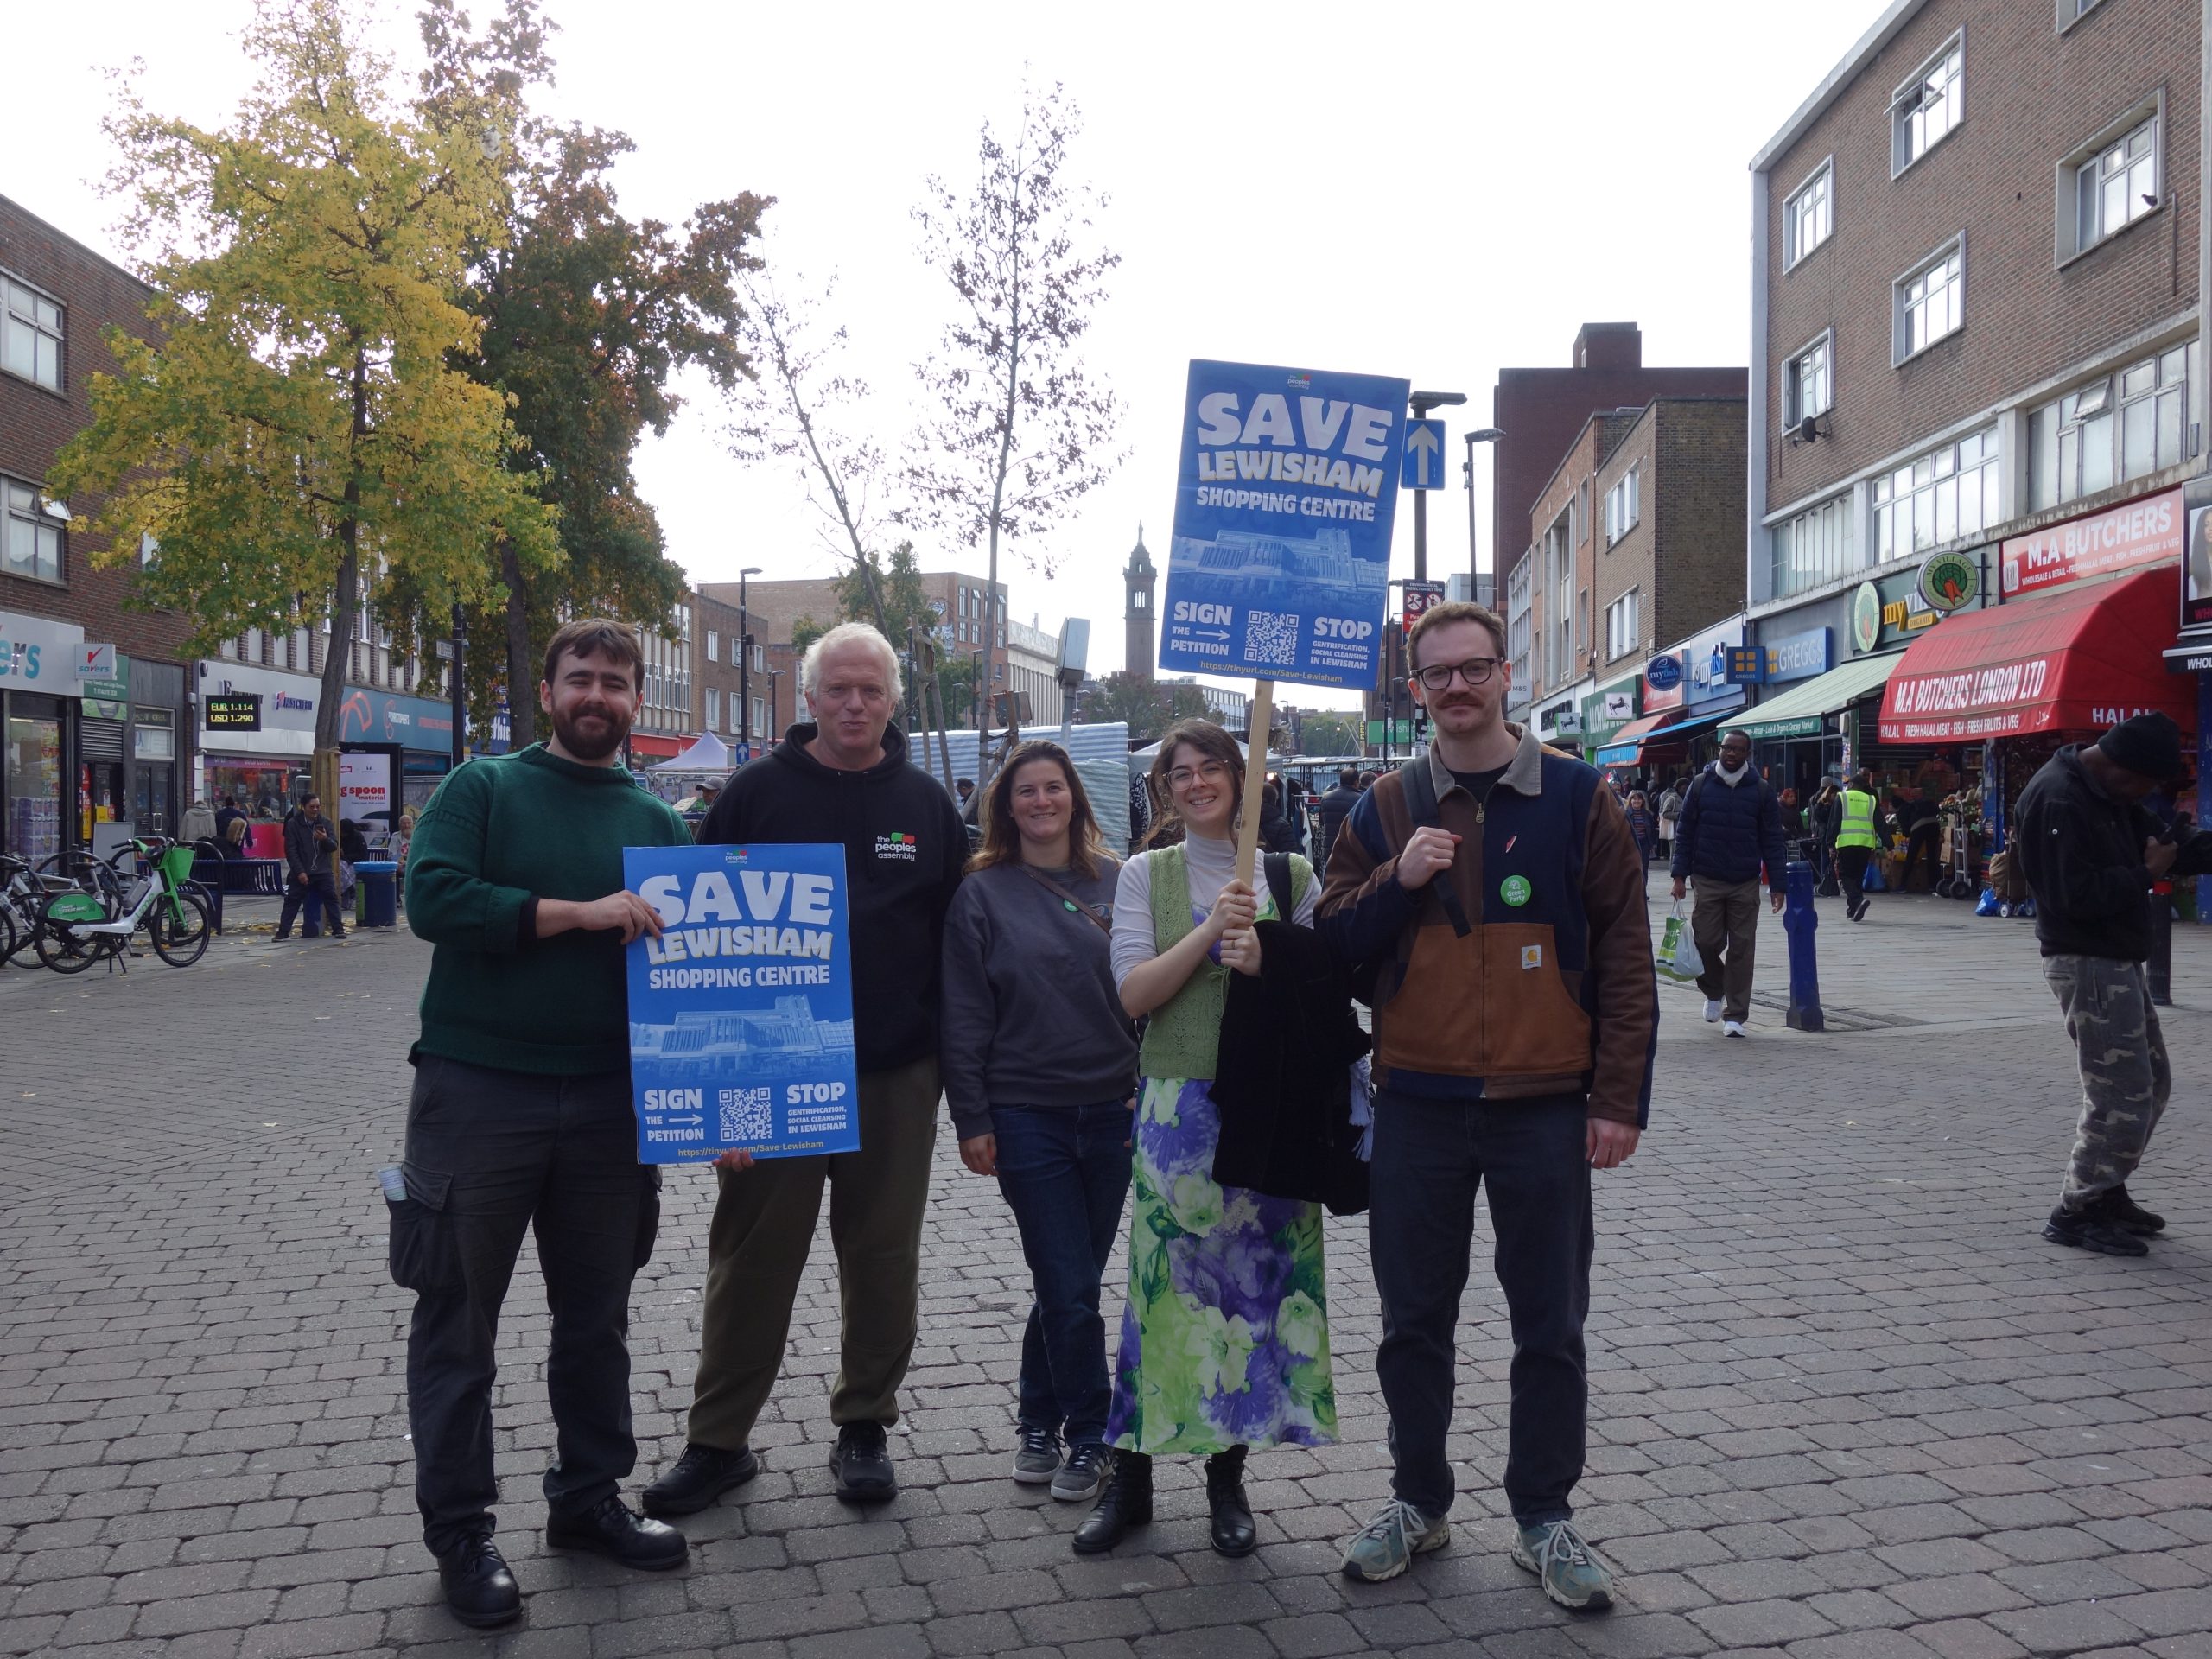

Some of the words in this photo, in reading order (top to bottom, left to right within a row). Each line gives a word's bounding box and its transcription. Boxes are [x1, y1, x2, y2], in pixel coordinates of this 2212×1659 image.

[1197, 392, 1393, 461] SAVE
[1198, 450, 1384, 498] LEWISHAM
[1197, 486, 1296, 514] SHOPPING
[1300, 496, 1376, 522] CENTRE
[2027, 535, 2061, 569] M.A
[2065, 501, 2171, 559] BUTCHERS
[2022, 572, 2048, 586] WHOLESALE
[2130, 546, 2145, 557] FRESH
[2168, 537, 2180, 548] VEG
[1173, 601, 1233, 626] SIGN
[1910, 615, 1932, 626] ORGANIC
[1172, 626, 1190, 636] THE
[1313, 616, 1372, 640] STOP
[1170, 639, 1229, 656] PETITION
[1311, 649, 1333, 658] SOCIAL
[1333, 652, 1369, 661] CLEANSING
[1312, 640, 1370, 654] GENTRIFICATION,
[1778, 638, 1823, 672] GREGGS
[1200, 661, 1343, 683] https://tinyurl.com/Save-Lewisham
[1322, 658, 1368, 670] LEWISHAM
[1649, 667, 1679, 680] myfish
[1894, 680, 1916, 713] M.A
[1915, 673, 1973, 713] BUTCHERS
[1971, 664, 2023, 706] LONDON
[2019, 659, 2047, 699] LTD
[211, 702, 228, 711] EUR
[1881, 724, 1900, 738] HALAL
[1905, 724, 1920, 737] FRESH
[1920, 724, 1936, 737] HALAL
[1936, 722, 1950, 736] MEAT
[1953, 721, 1965, 735] FISH
[1967, 719, 1984, 734] FRESH
[1983, 716, 2002, 731] FRUITS
[2002, 717, 2006, 730] &
[2007, 714, 2019, 728] VEG
[349, 786, 385, 797] spoon
[875, 842, 916, 853] peoples
[878, 852, 915, 861] assembly
[639, 870, 834, 928] SAVE
[1507, 888, 1525, 897] Green
[645, 925, 834, 965] LEWISHAM
[650, 967, 752, 989] SHOPPING
[755, 964, 830, 986] CENTRE
[645, 1088, 703, 1111] SIGN
[786, 1082, 846, 1104] STOP
[787, 1105, 848, 1116] GENTRIFICATION,
[787, 1116, 810, 1124] SOCIAL
[810, 1114, 846, 1123] CLEANSING
[645, 1116, 663, 1125] THE
[788, 1123, 798, 1134] IN
[800, 1122, 847, 1134] LEWISHAM
[647, 1128, 704, 1141] PETITION
